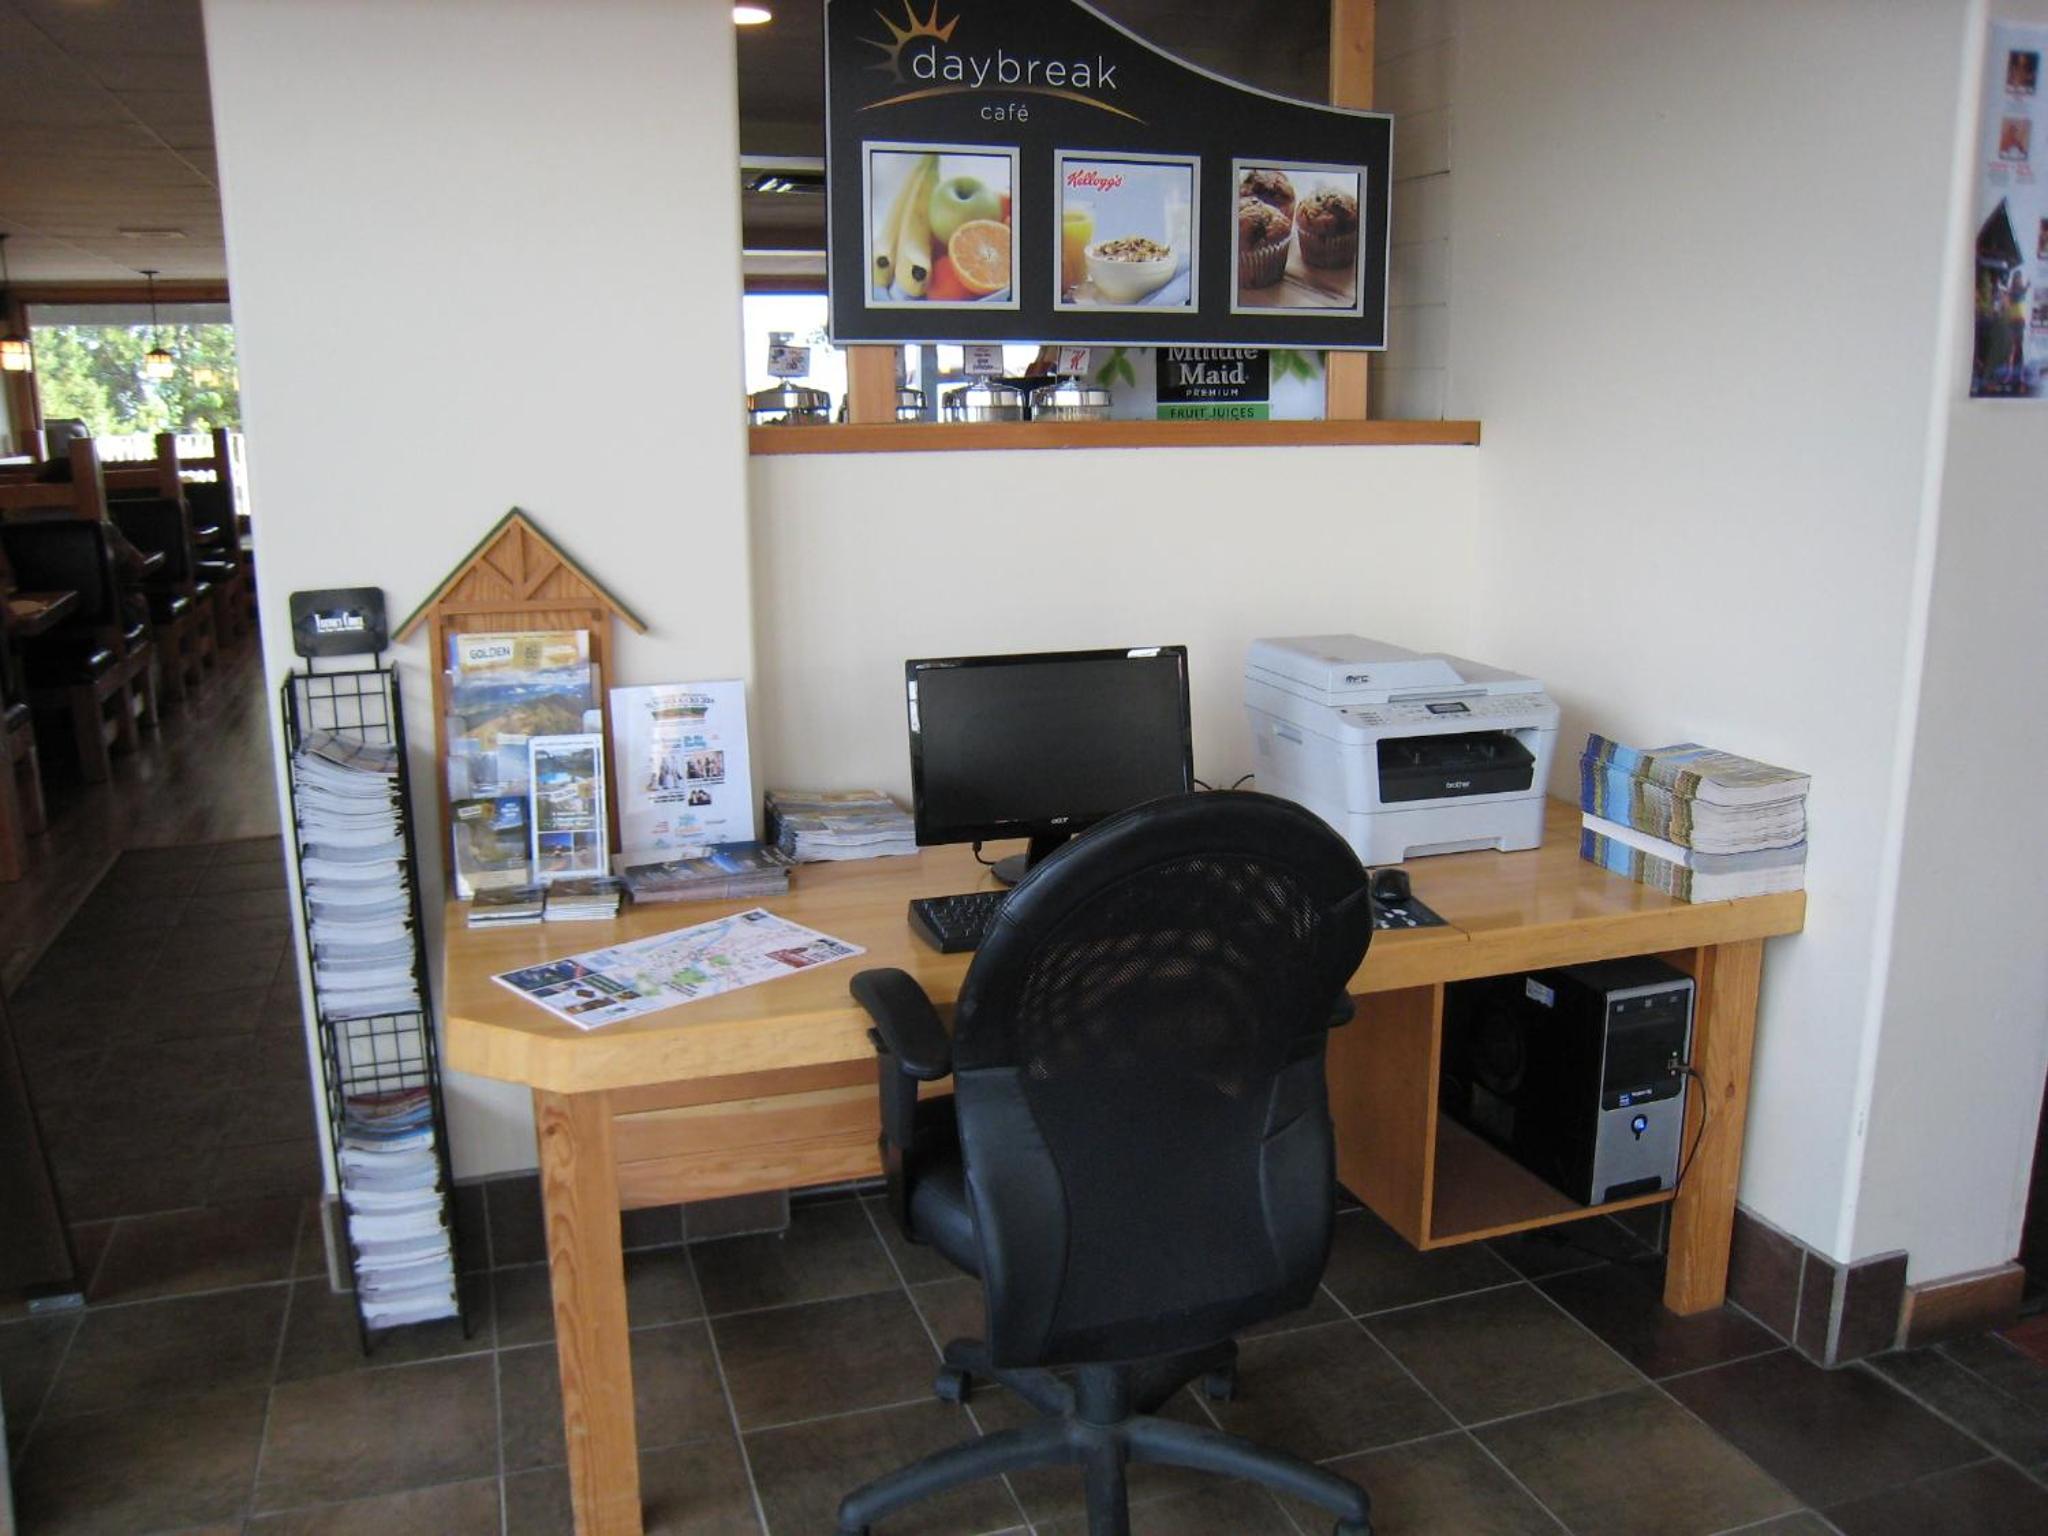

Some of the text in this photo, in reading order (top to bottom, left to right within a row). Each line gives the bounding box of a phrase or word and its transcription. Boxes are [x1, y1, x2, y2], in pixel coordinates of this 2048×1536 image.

[912, 45, 1118, 90] daybreak
[981, 103, 1029, 122] café
[1067, 169, 1123, 192] Kellogg's
[1179, 362, 1246, 386] Maid
[1185, 388, 1240, 397] PREMIUM
[1170, 407, 1255, 418] FRUIT JUICES
[469, 646, 511, 660] GOLDEN
